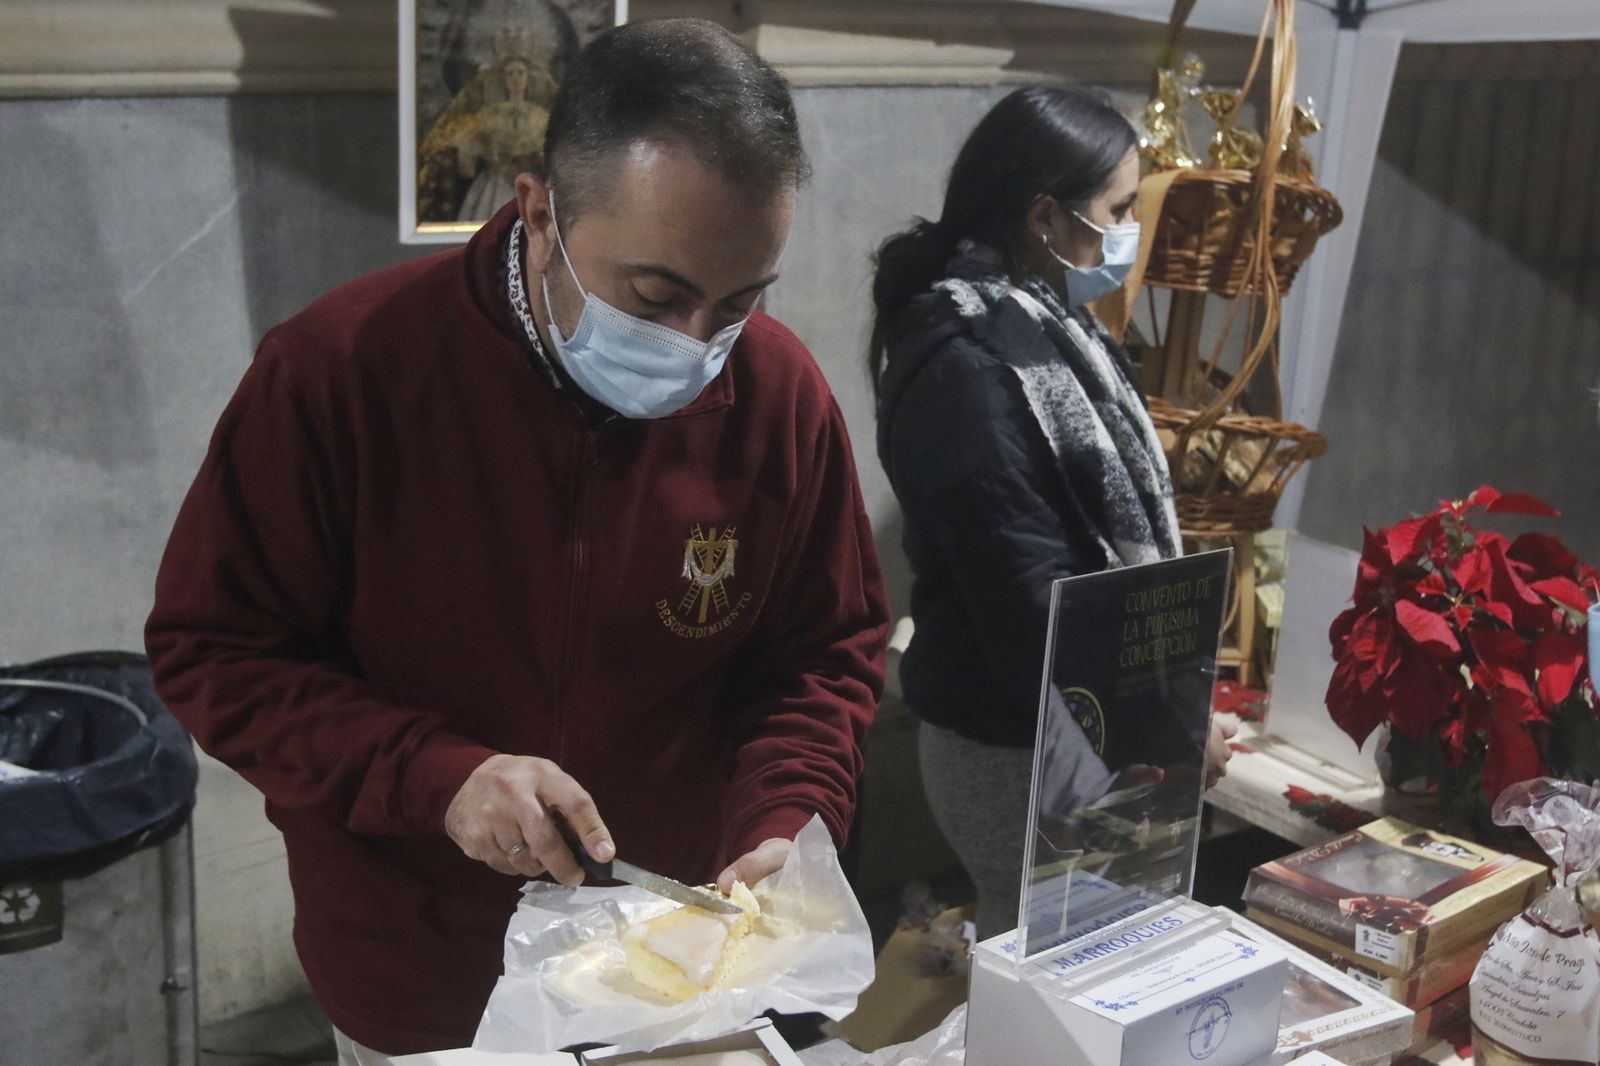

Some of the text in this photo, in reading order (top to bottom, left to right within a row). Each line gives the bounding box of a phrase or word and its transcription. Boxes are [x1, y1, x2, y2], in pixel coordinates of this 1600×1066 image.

[656, 592, 752, 638] DESCENDIMIENTO
[1126, 575, 1214, 613] CONVENTO DE
[1123, 620, 1139, 641] LA
[1053, 916, 1184, 969] MARROQUIES
